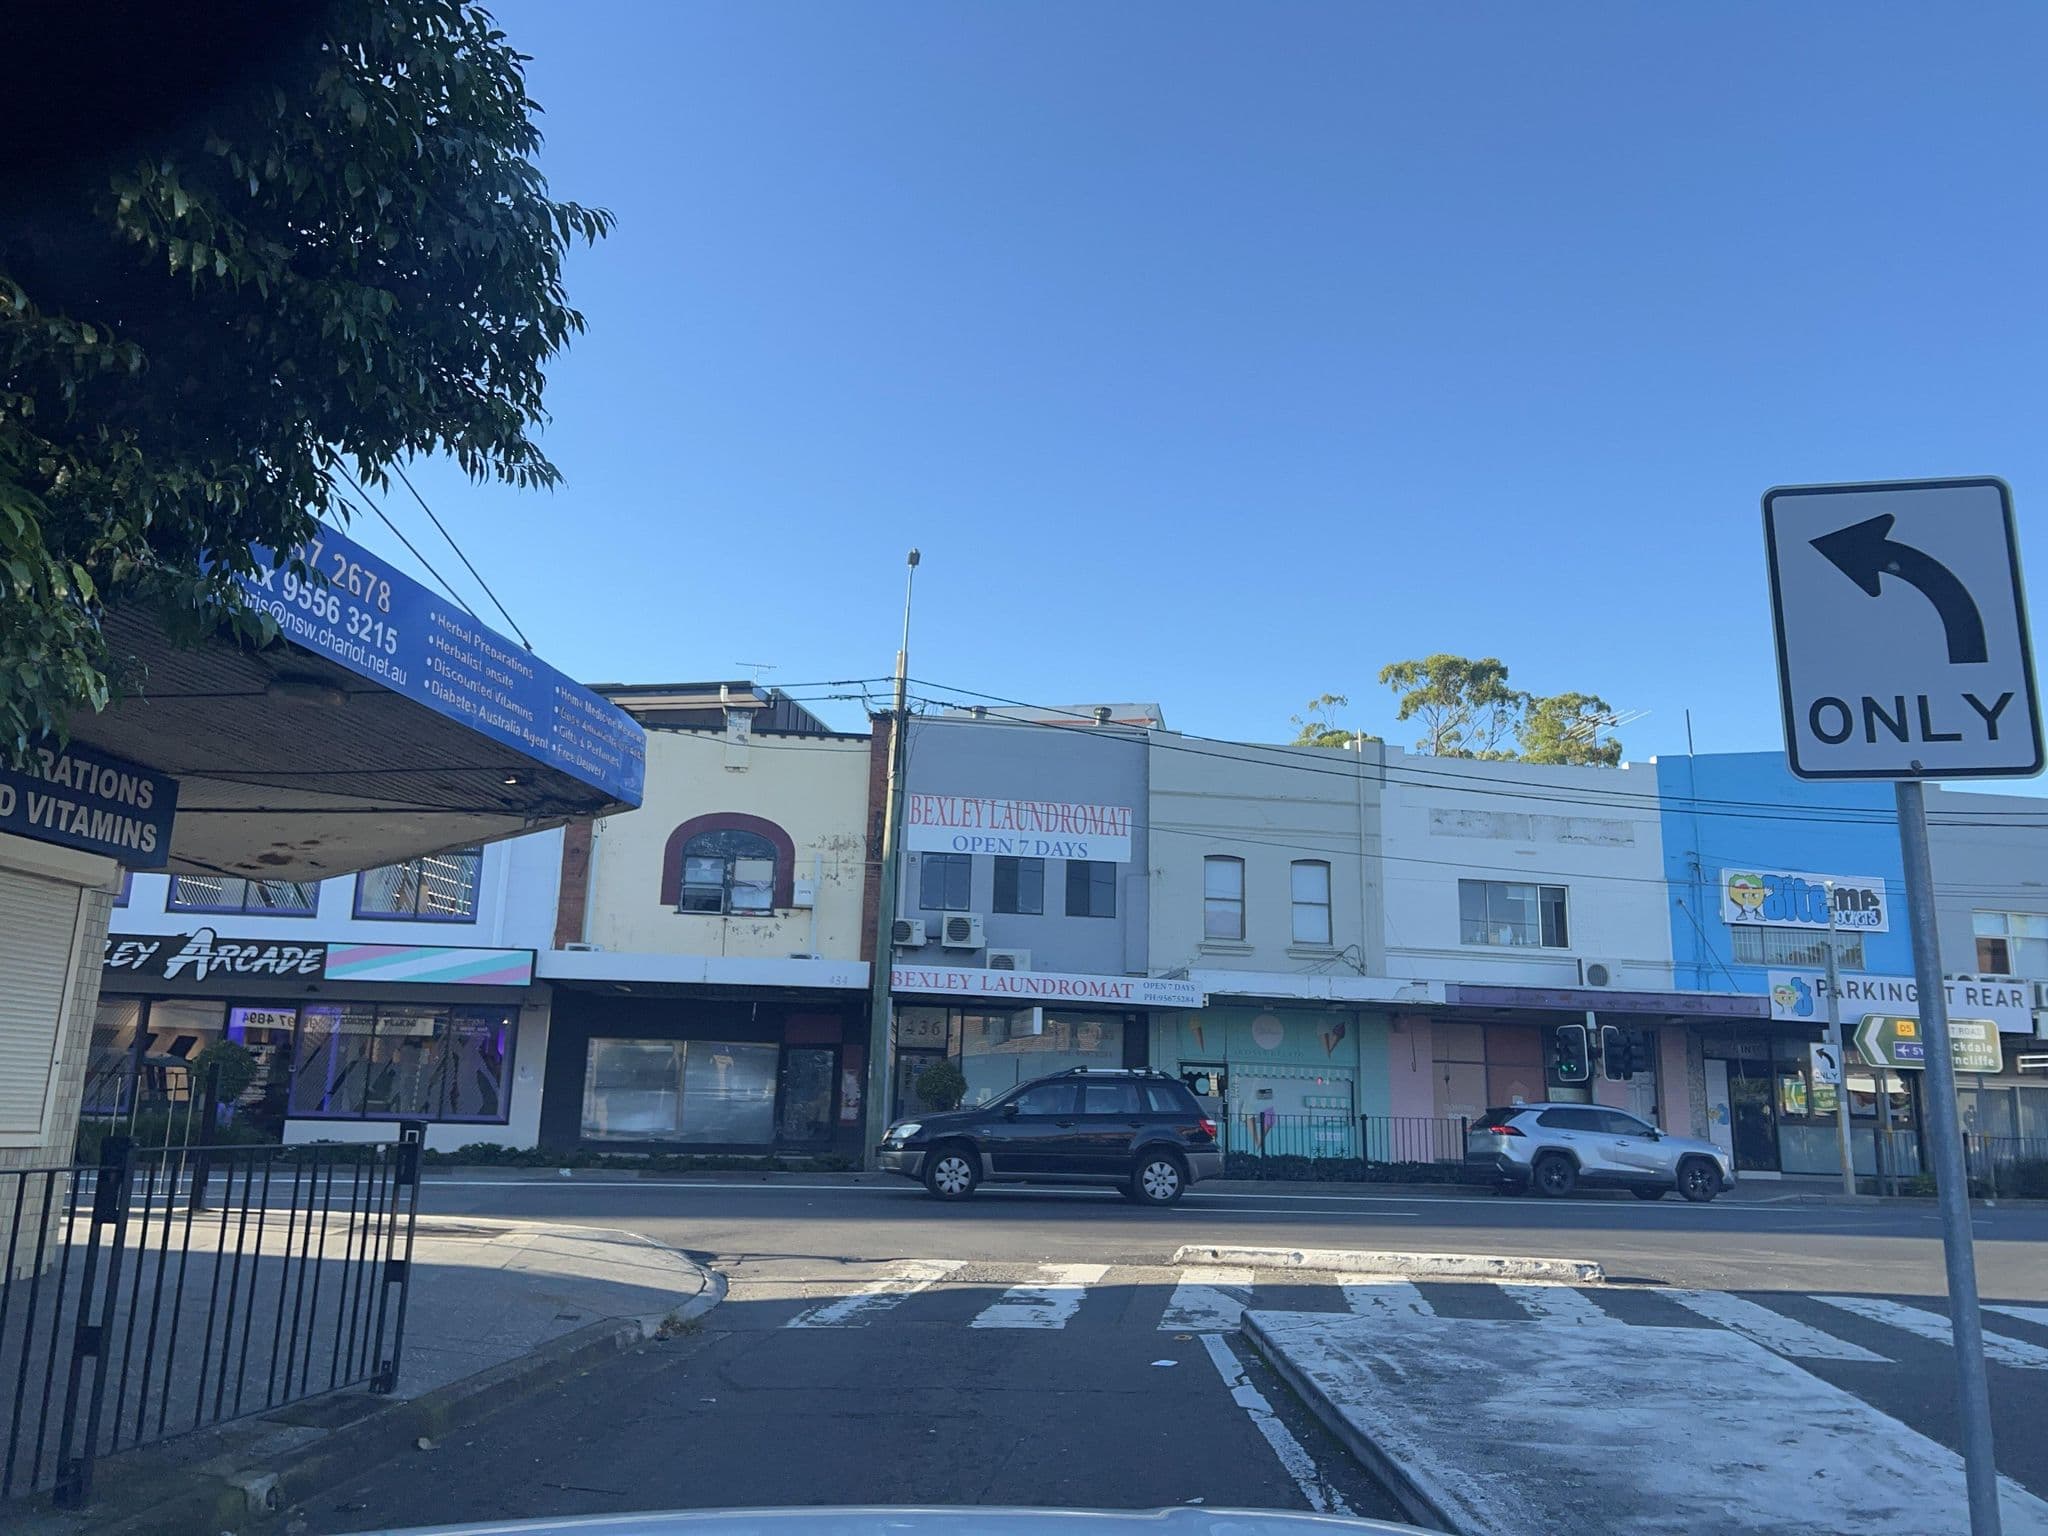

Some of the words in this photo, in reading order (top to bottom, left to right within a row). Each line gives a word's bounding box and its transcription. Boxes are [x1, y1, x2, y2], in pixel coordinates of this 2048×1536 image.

[330, 553, 392, 613] 2678
[283, 571, 341, 625] 9556
[346, 606, 398, 655] 3215
[436, 635, 482, 672] Herbalist
[485, 666, 514, 689] onsite
[438, 613, 472, 643] Herbal
[474, 634, 534, 679] Preparations
[434, 658, 493, 699] Discounted
[494, 692, 534, 722] Vitamins
[431, 680, 477, 715] Diabetes
[479, 706, 521, 737] Australia
[522, 728, 549, 749] Agent
[1808, 692, 2015, 744] ONLY
[557, 744, 575, 763] Free
[576, 756, 606, 781] Delivery
[559, 726, 578, 745] Gifts
[587, 740, 621, 768] Perfumes
[27, 791, 158, 853] VITAMINS
[908, 795, 988, 828] BEXLEY
[988, 800, 1132, 837] LAUNDROMAT
[952, 835, 1014, 855] OPEN
[1019, 840, 1030, 855] 7
[1036, 841, 1088, 858] DAYS
[1834, 887, 1882, 926] me
[891, 970, 973, 991] BEXLEY
[982, 974, 1135, 999] LAUNDROMAT
[1143, 981, 1167, 990] OPEN
[1174, 983, 1196, 991] DAYS
[1966, 987, 2025, 1008] REAR
[1952, 1055, 1995, 1067] ncliffe
[1953, 1041, 1993, 1054] ckdale
[1815, 1071, 1838, 1080] ONLY
